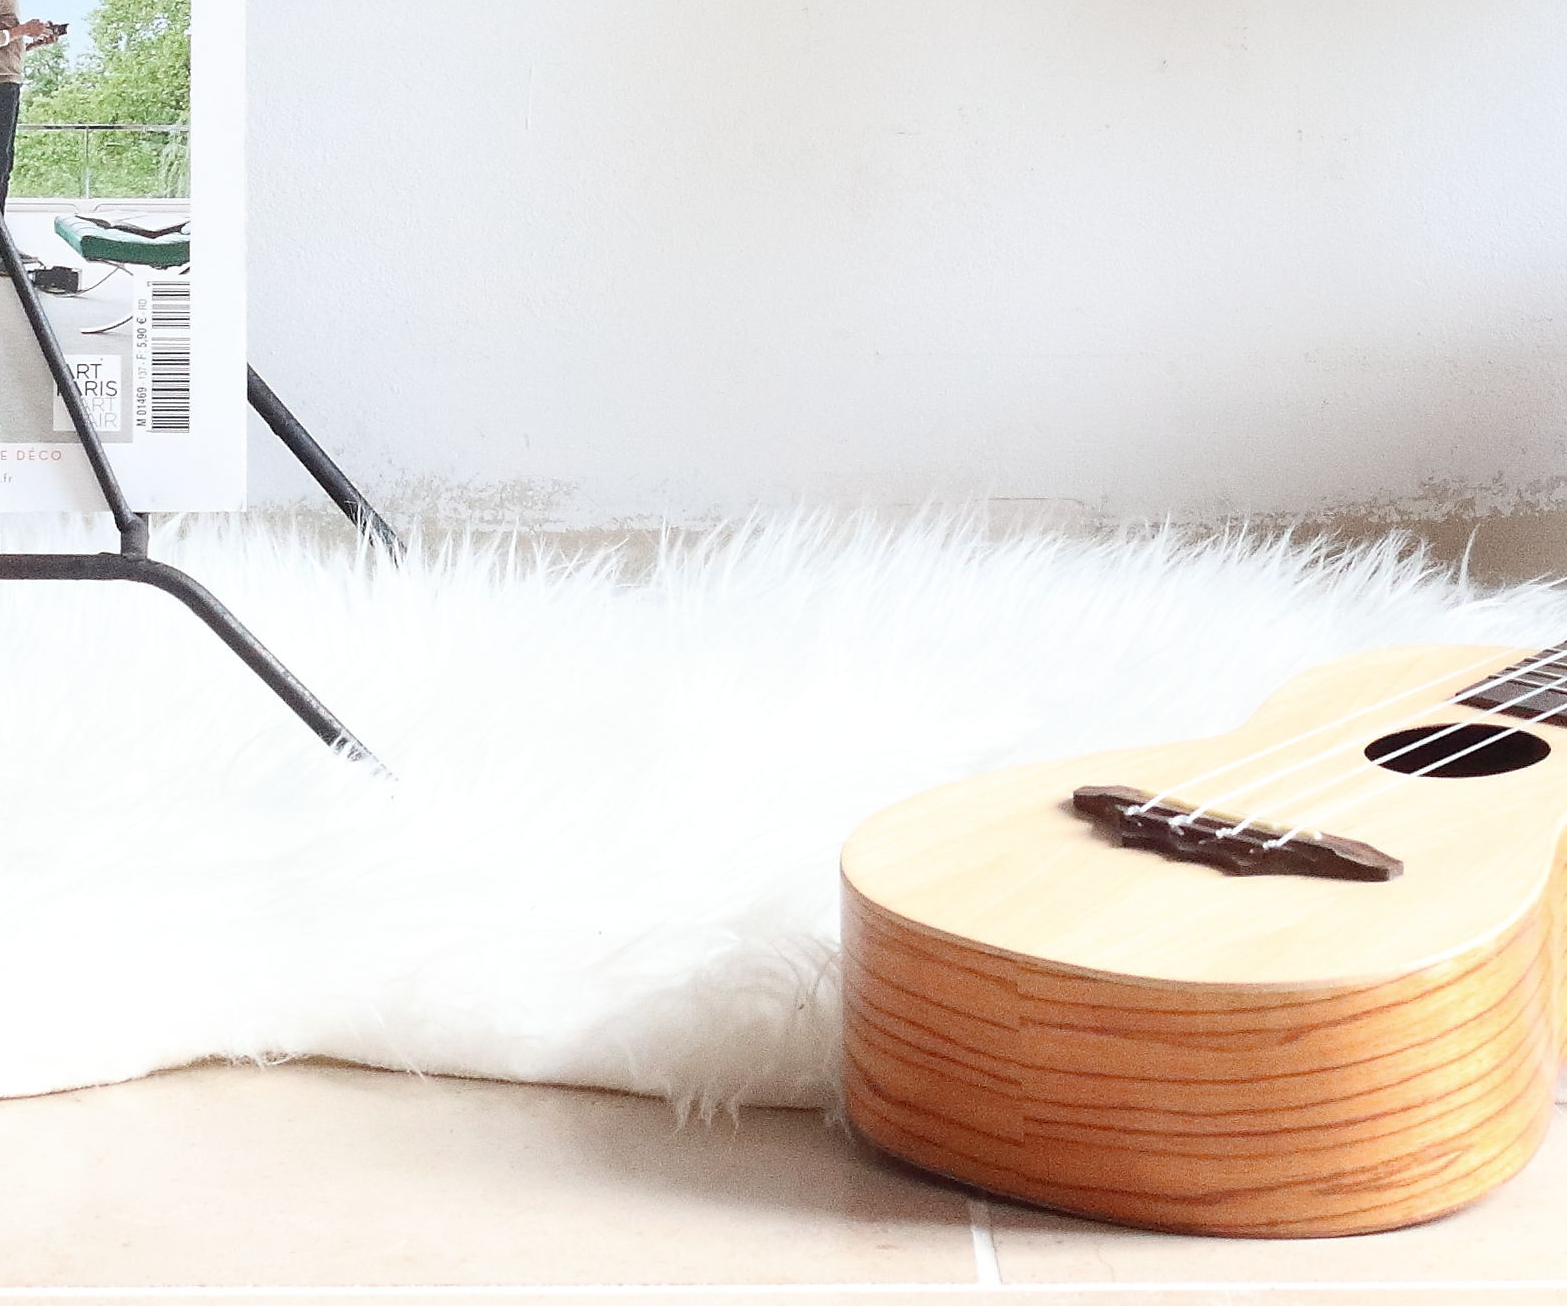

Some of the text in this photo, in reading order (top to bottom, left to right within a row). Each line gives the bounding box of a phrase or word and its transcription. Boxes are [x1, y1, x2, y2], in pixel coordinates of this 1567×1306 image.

[136, 327, 149, 348] 5,90
[136, 386, 147, 416] 01469
[16, 447, 62, 462] DÉCO
